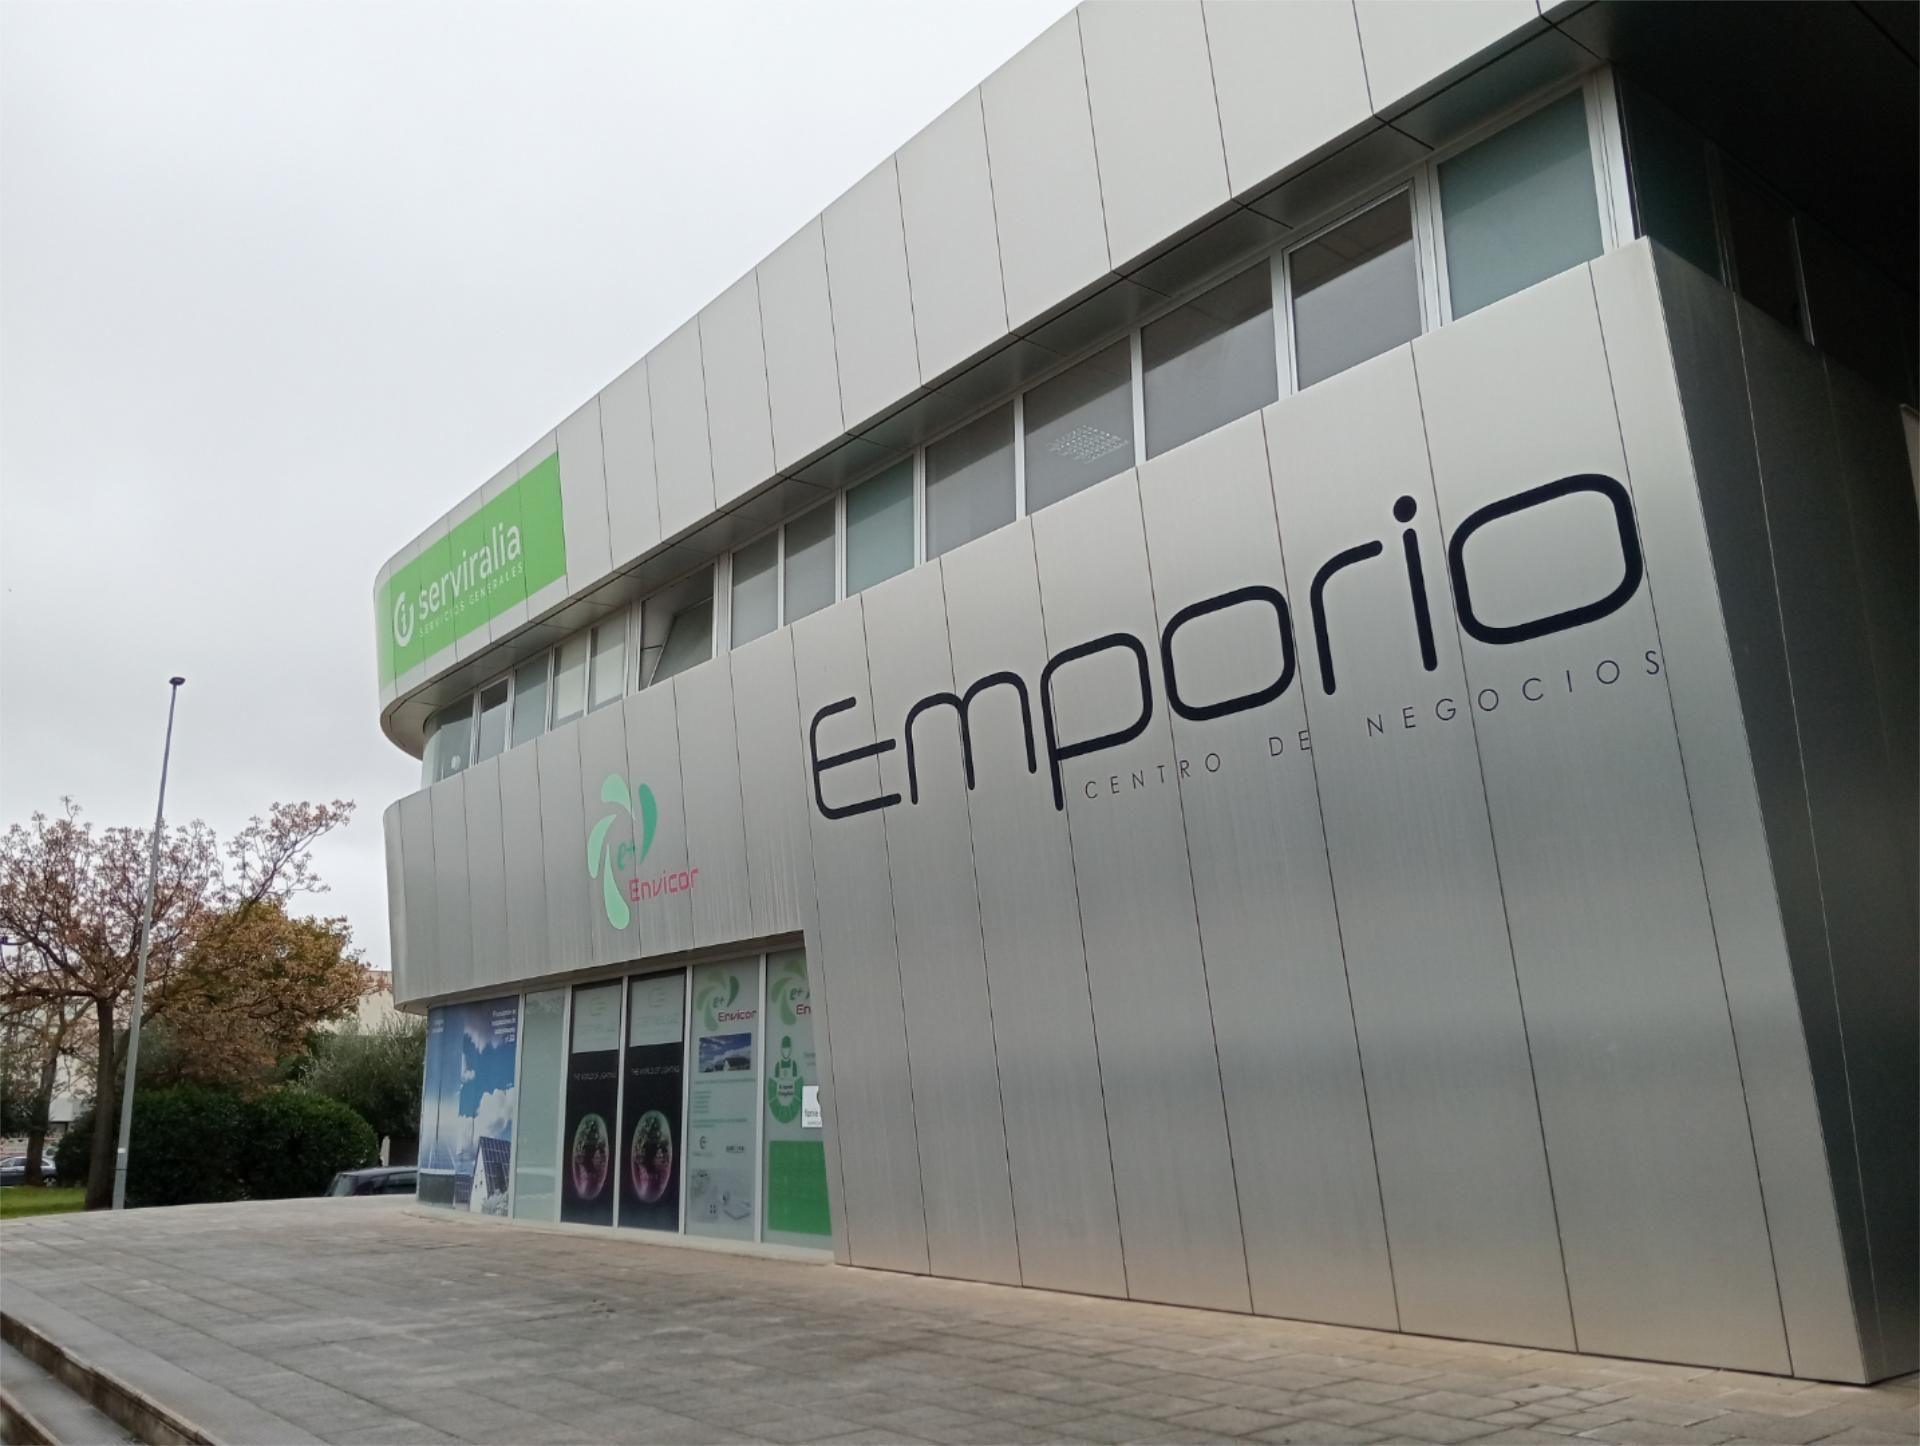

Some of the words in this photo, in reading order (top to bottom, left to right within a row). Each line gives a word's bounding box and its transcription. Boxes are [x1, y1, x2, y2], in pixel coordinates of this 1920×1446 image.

[418, 521, 522, 621] serviralia
[809, 473, 1643, 820] Emporio
[1084, 753, 1221, 800] CENTRO
[1268, 729, 1313, 757] DE
[1366, 649, 1661, 738] NEGOCIOS
[628, 867, 699, 902] Envicor
[717, 1009, 757, 1022] Envicor
